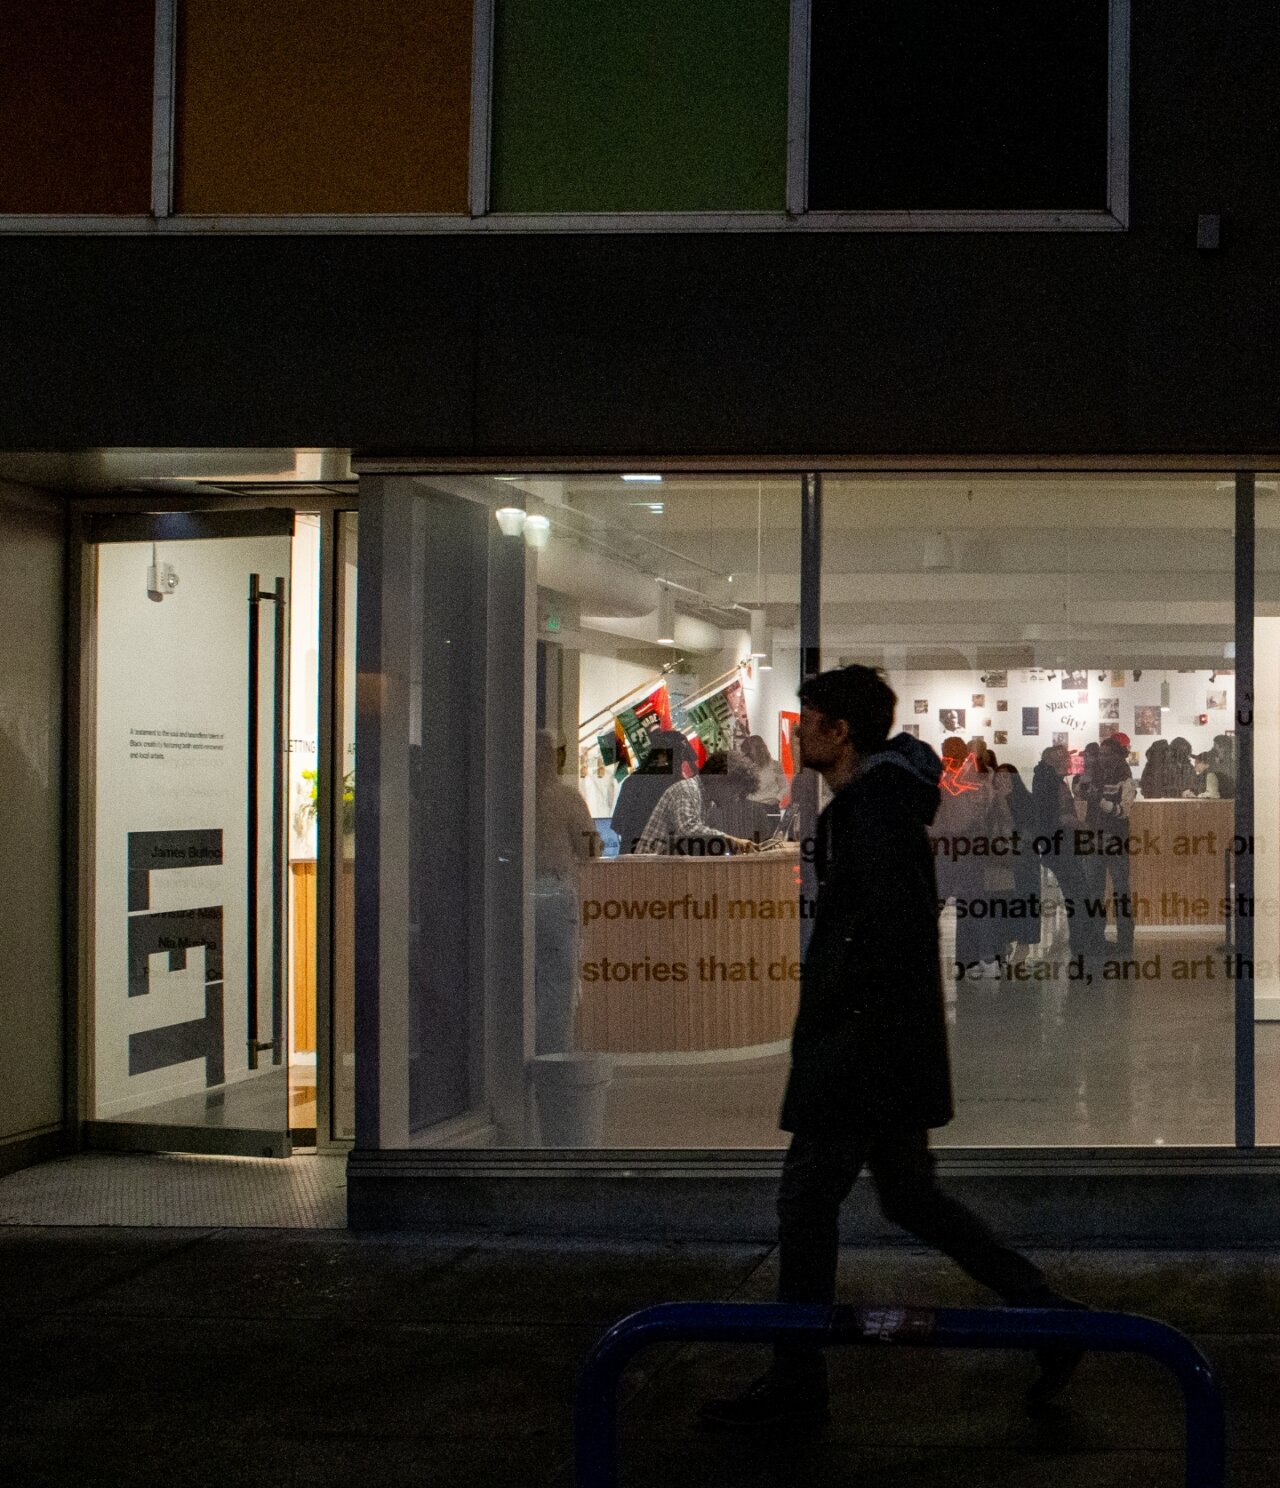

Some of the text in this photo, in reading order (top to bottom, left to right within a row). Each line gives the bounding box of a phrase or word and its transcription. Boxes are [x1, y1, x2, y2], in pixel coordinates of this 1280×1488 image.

[1045, 699, 1075, 713] space
[1060, 713, 1087, 731] city!
[151, 846, 186, 858] James
[1032, 829, 1063, 856] of
[1073, 829, 1161, 856] Black
[1172, 830, 1217, 855] art
[582, 894, 717, 926] powerful
[1084, 891, 1150, 918] with
[1160, 891, 1209, 918] the
[582, 956, 689, 983] stories
[697, 956, 759, 982] that
[1103, 954, 1161, 980] and
[1171, 954, 1215, 980] art
